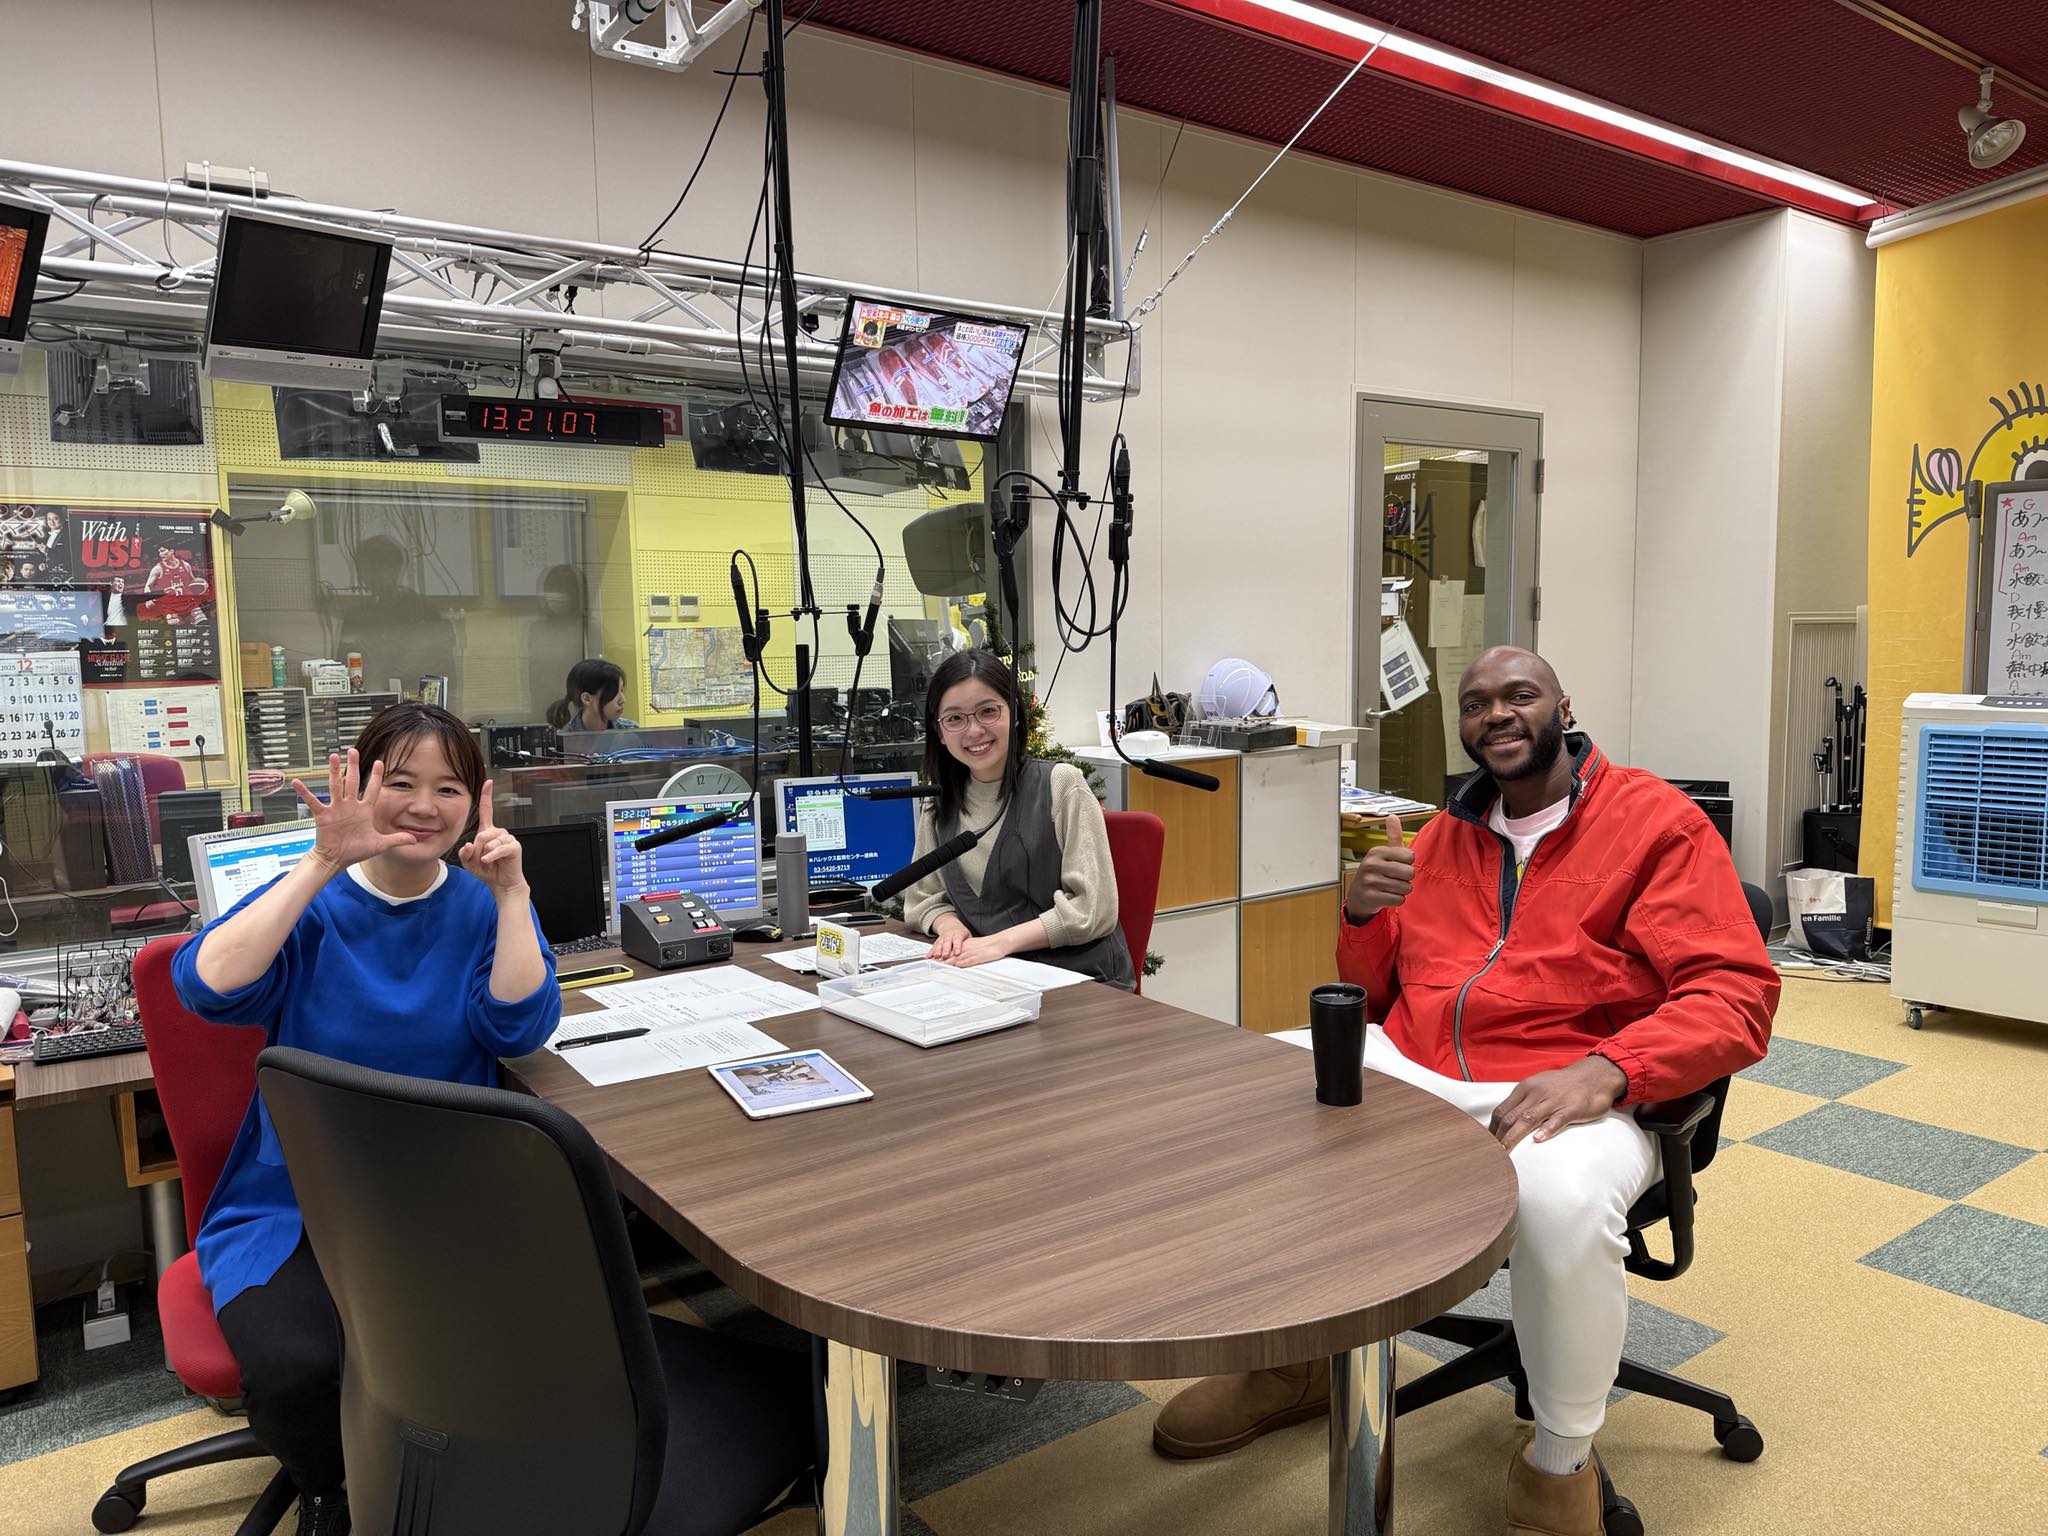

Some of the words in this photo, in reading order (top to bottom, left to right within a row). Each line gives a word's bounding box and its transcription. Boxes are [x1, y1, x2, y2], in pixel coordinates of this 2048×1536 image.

[869, 402, 967, 425] 魚の加工は無料!
[1395, 473, 1411, 481] AUDIO
[2023, 498, 2036, 511] G
[81, 520, 127, 542] With
[2017, 531, 2037, 542] Am
[81, 537, 143, 568] US!
[2013, 563, 2030, 574] Am
[2011, 592, 2021, 604] D
[2011, 621, 2022, 632] D
[2011, 649, 2032, 661] Am
[17, 660, 33, 671] 12
[9, 677, 15, 687] 2
[24, 677, 30, 686] 3
[39, 676, 45, 685] 4
[53, 676, 60, 685] 5
[68, 675, 74, 684] 6
[2009, 679, 2019, 690] A
[10, 695, 16, 704] 9
[23, 695, 34, 704] 10
[37, 694, 47, 703] 11
[53, 694, 63, 703] 12
[67, 693, 78, 702] 13
[9, 713, 20, 723] 16
[24, 713, 35, 722] 17
[40, 712, 50, 721] 18
[54, 711, 65, 720] 19
[69, 711, 79, 720] 20
[11, 731, 21, 740] 23
[26, 730, 36, 740] 24
[56, 729, 66, 738] 26
[70, 728, 80, 738] 27
[12, 749, 23, 758] 30
[27, 748, 37, 757] 31
[696, 774, 705, 785] 12
[640, 817, 651, 830] 16
[1813, 914, 1842, 922] Famille
